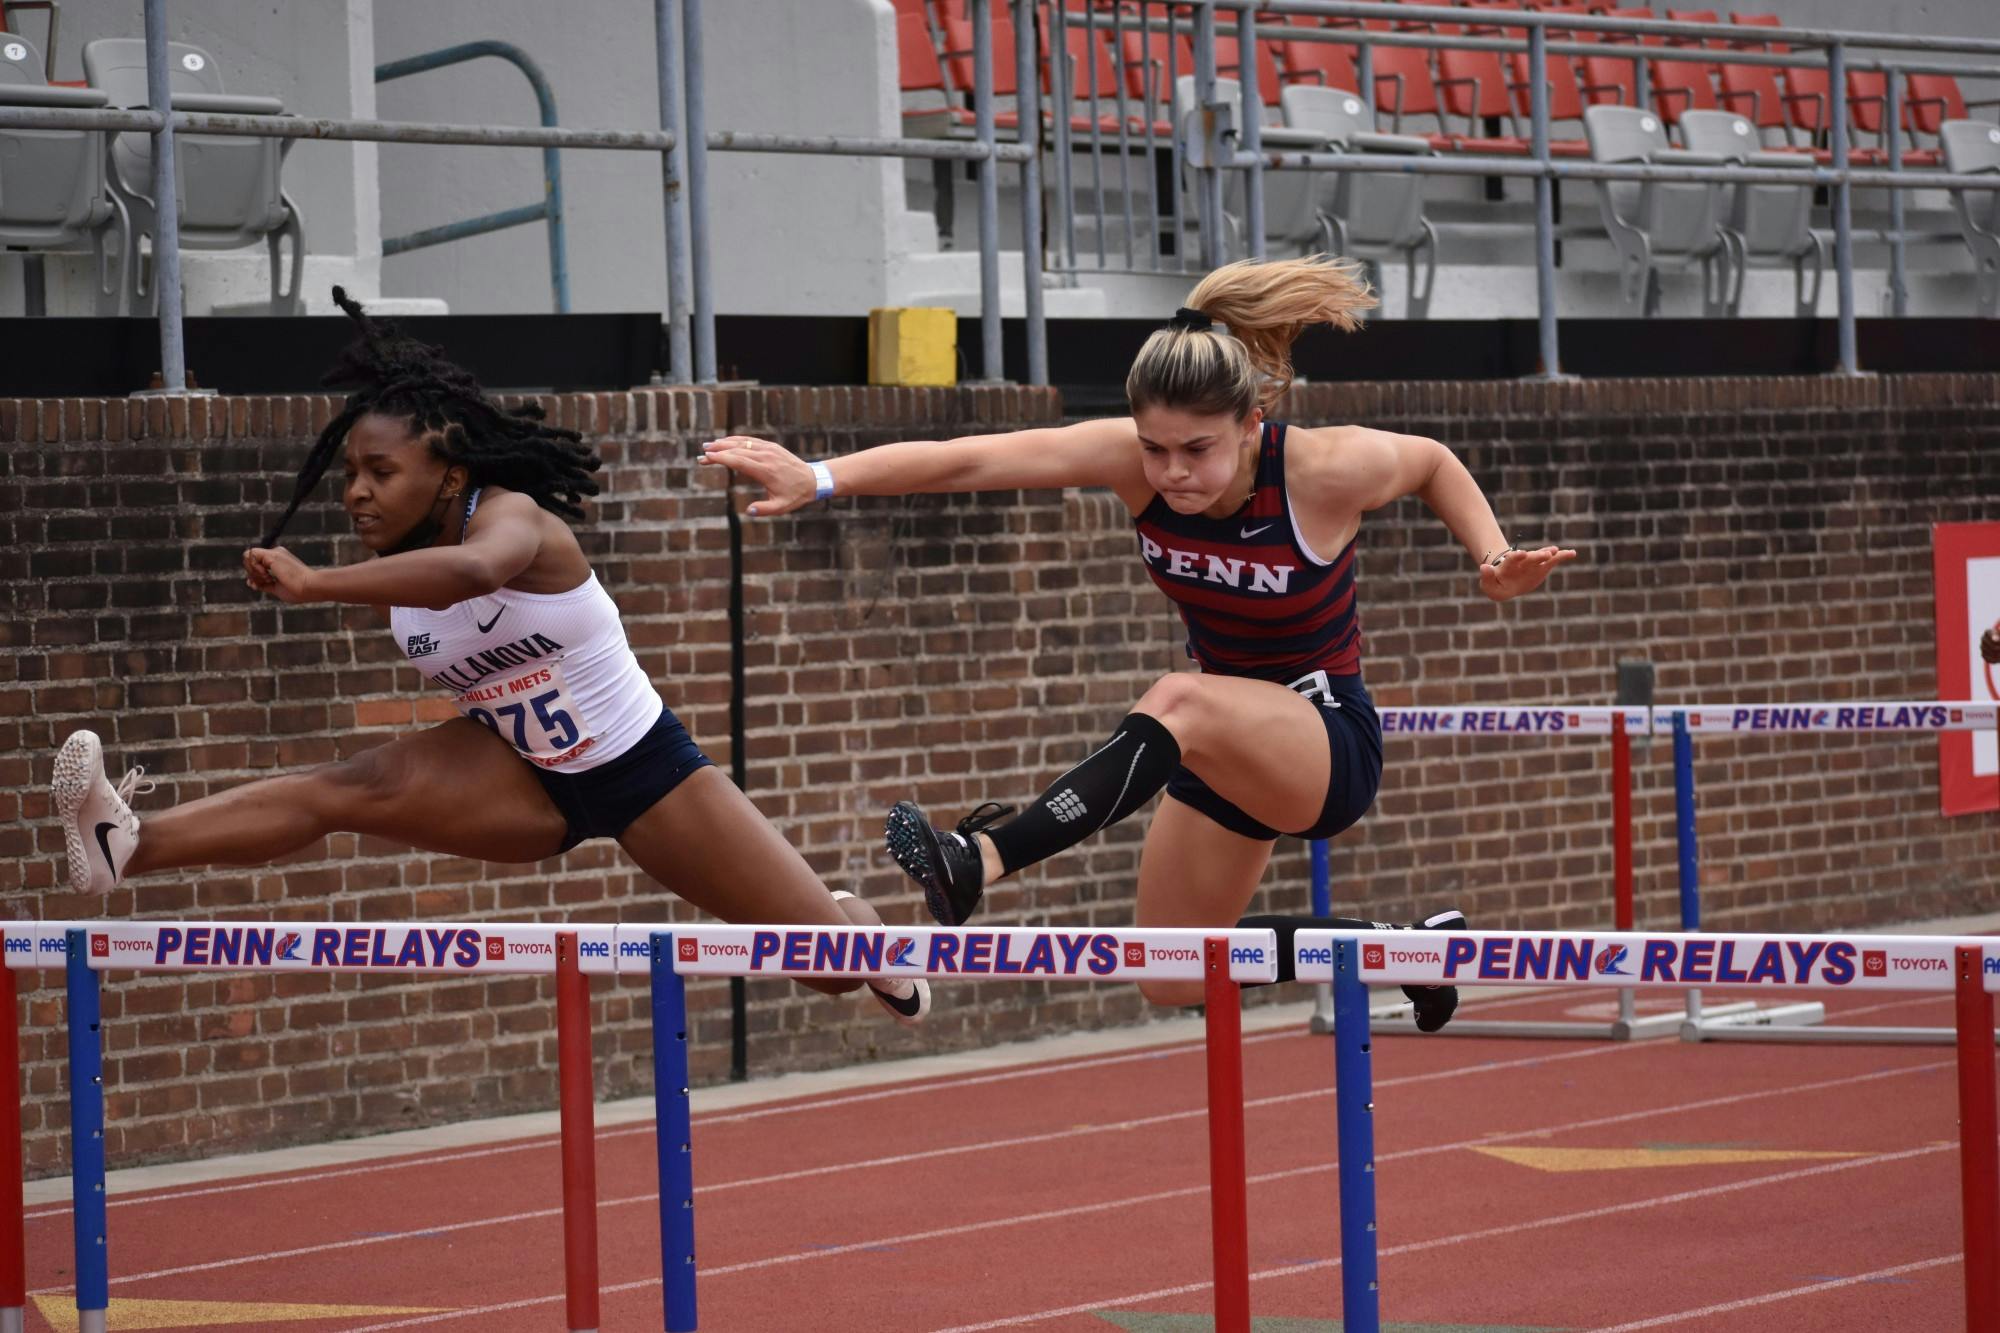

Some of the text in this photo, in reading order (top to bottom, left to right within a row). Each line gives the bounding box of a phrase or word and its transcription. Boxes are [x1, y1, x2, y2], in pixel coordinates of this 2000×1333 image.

[1139, 532, 1294, 593] PENN
[408, 632, 431, 646] BIG
[408, 640, 440, 655] EAST
[431, 633, 564, 693] ILLANOVA
[508, 668, 552, 694] METS
[1381, 711, 1565, 732] ENN RELAYS
[1732, 706, 1948, 729] PENN RELAYS
[112, 940, 154, 952] TOYOTA
[155, 928, 482, 968] PENN RELAYS
[508, 943, 553, 954] TOYOTA
[702, 944, 749, 957] TOYOTA
[750, 931, 1120, 976] PENN RELAYS
[1149, 949, 1200, 961] TOYOTA
[1389, 951, 1441, 963] TOYOTA
[1443, 937, 1857, 985] PENN RELAYS
[1891, 958, 1948, 971] TOYOTA
